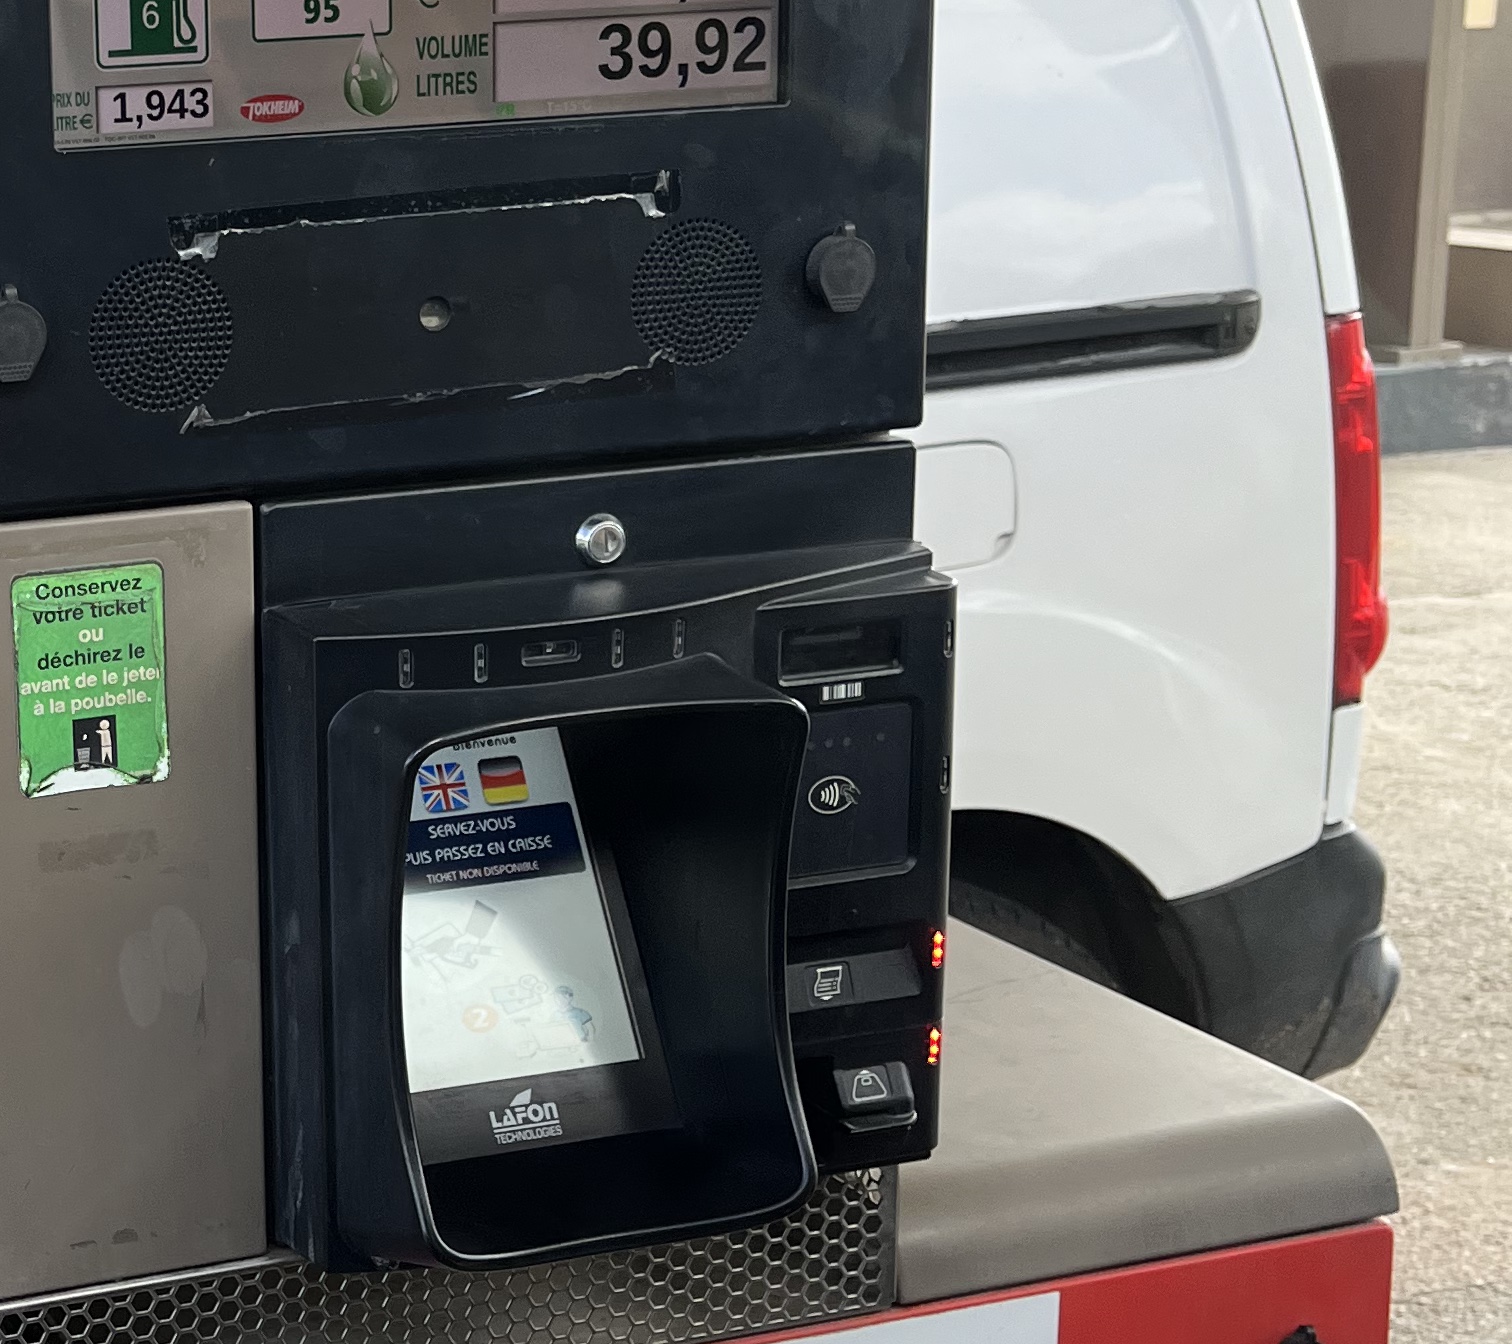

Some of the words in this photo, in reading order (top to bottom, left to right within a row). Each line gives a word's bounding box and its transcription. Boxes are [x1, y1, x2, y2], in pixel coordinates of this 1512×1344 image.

[141, 1, 160, 31] 6
[416, 33, 489, 61] VOLUME
[597, 15, 768, 87] 39,92
[416, 70, 478, 98] LITRES
[74, 91, 90, 106] DU
[113, 87, 210, 129] 1,943
[241, 100, 300, 120] TOKHEIM
[80, 114, 94, 130] €
[35, 577, 143, 600] Conservez
[32, 607, 84, 625] votre
[90, 598, 147, 618] ticket
[78, 627, 104, 643] ou
[37, 650, 122, 670] déchirez
[128, 643, 145, 660] le
[20, 675, 71, 696] avant
[75, 671, 98, 688] de
[103, 669, 118, 684] le
[33, 700, 45, 717] à
[50, 698, 66, 714] la
[71, 689, 152, 714] poubelle.
[428, 815, 517, 839] SERVEZ-VOUS
[435, 846, 485, 862] PASSEZ
[488, 843, 505, 856] EN
[508, 835, 552, 852] CAISSE
[426, 871, 458, 885] TICKET
[460, 869, 482, 880] NON
[484, 860, 540, 878] DISPONIBLE
[472, 1008, 488, 1026] 2
[494, 1125, 563, 1145] TECHNOLOGIES
